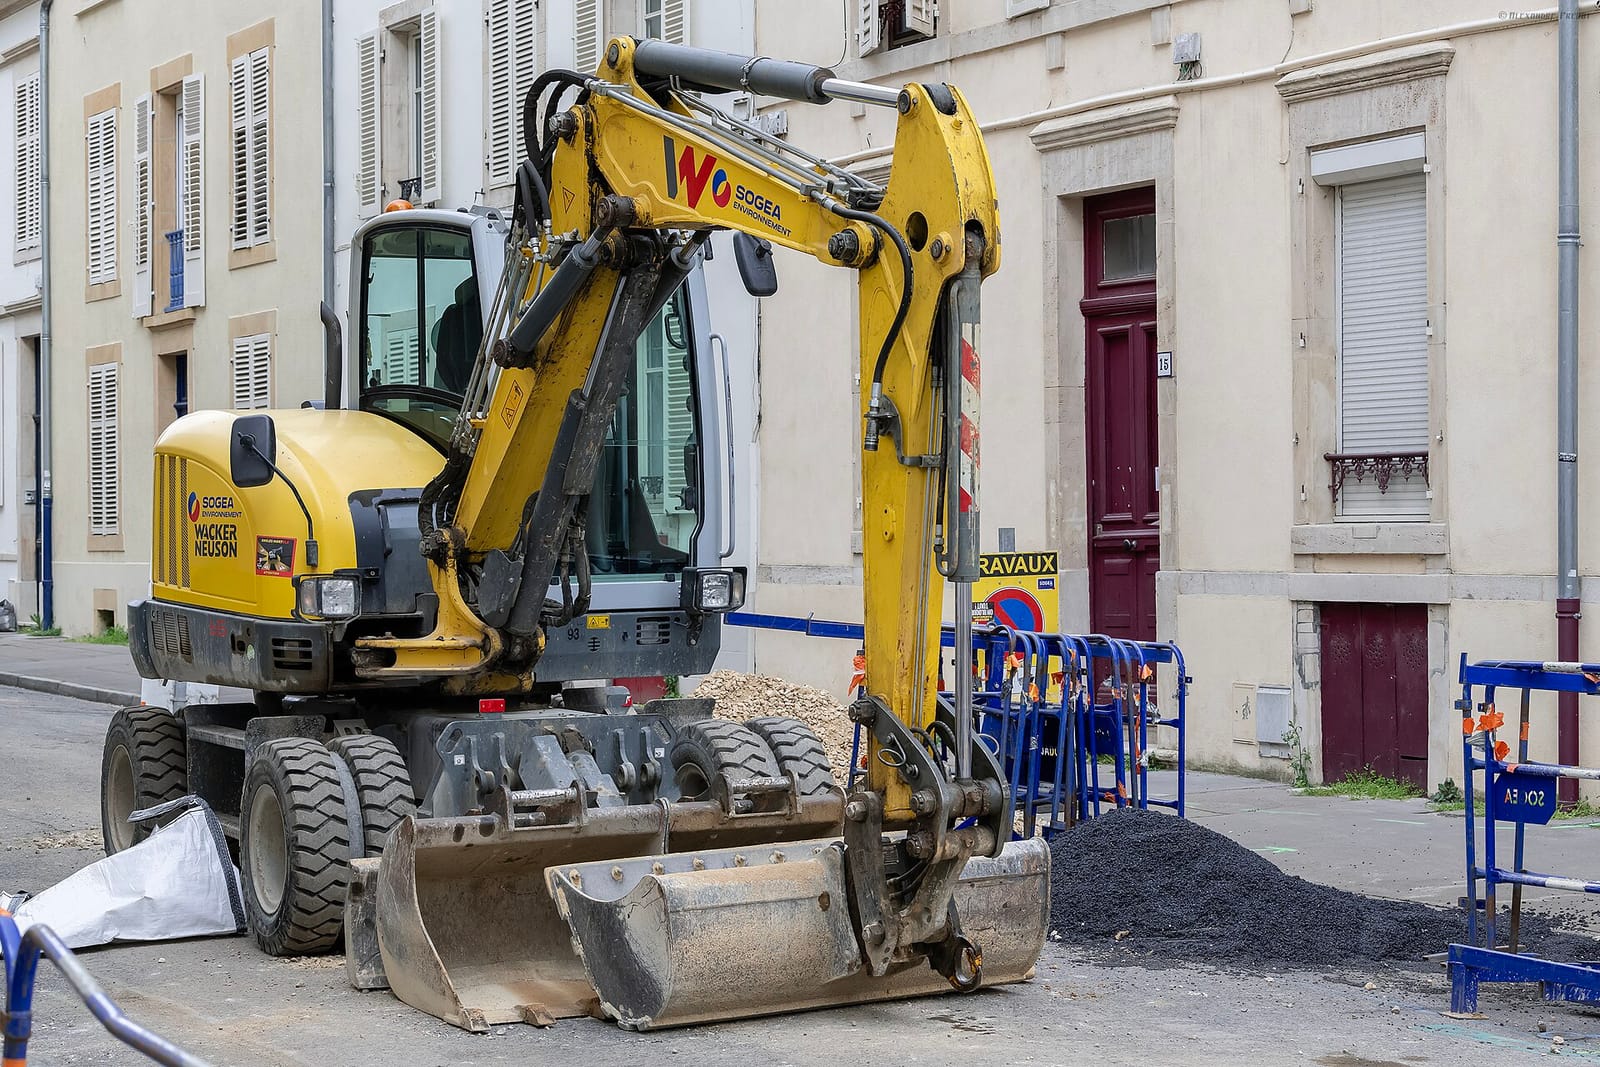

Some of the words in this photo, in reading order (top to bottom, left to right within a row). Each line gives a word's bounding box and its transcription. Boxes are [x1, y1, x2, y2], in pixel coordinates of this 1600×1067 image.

[735, 184, 781, 221] SOGEA
[733, 201, 792, 238] ENVIRONNEMENT
[1159, 358, 1169, 371] 15
[202, 496, 234, 509] SOGEA
[194, 523, 237, 541] WACKER
[194, 540, 237, 558] NEUSON
[567, 627, 580, 641] 93
